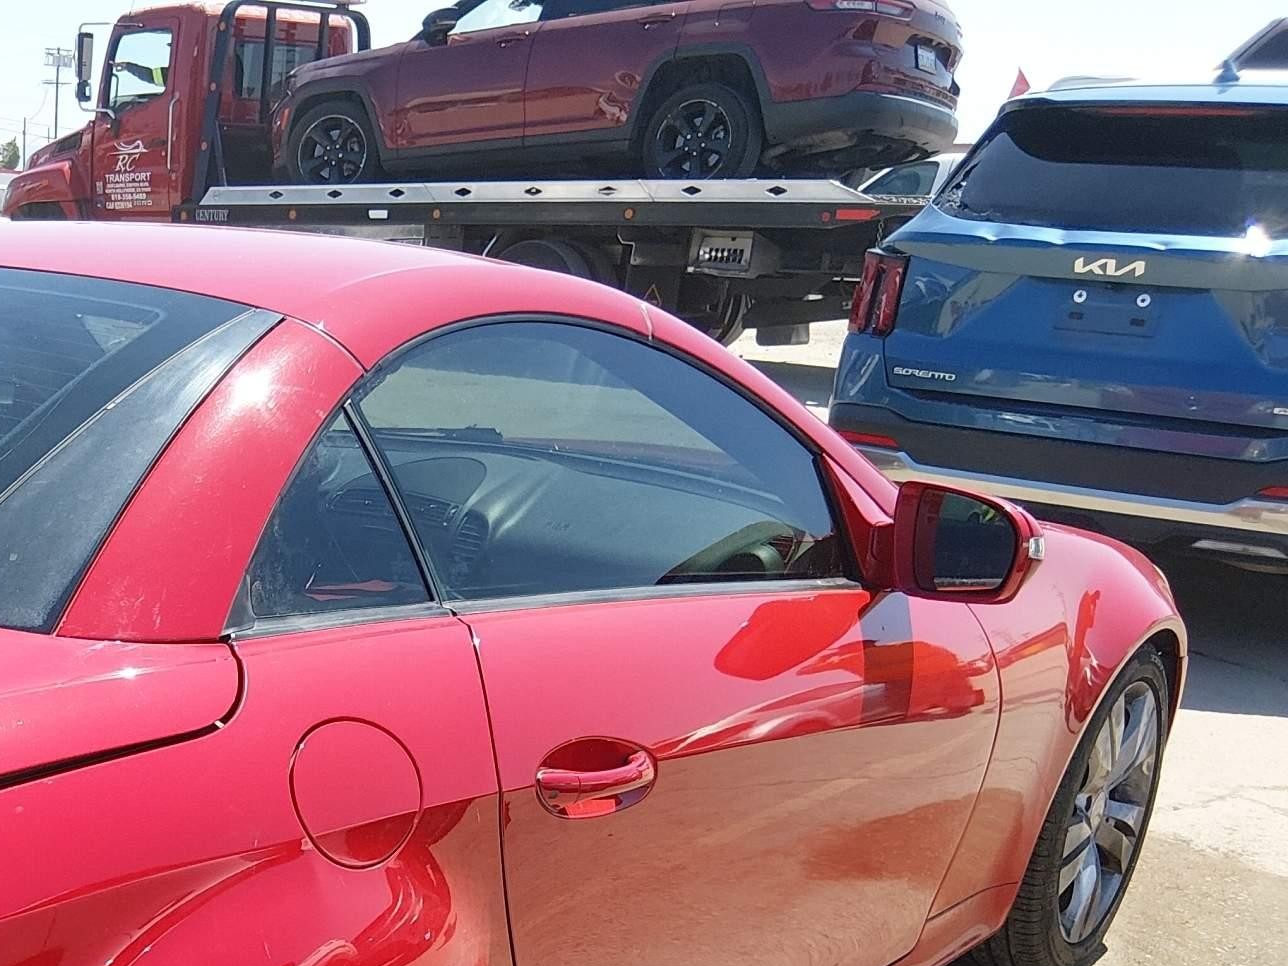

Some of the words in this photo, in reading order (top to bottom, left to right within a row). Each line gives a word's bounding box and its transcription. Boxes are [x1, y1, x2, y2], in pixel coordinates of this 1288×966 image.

[115, 153, 140, 172] RC
[105, 172, 152, 183] TRANSPORT
[195, 209, 230, 221] CENTURY
[1074, 256, 1146, 277] KIA
[893, 366, 956, 381] SORENTO
